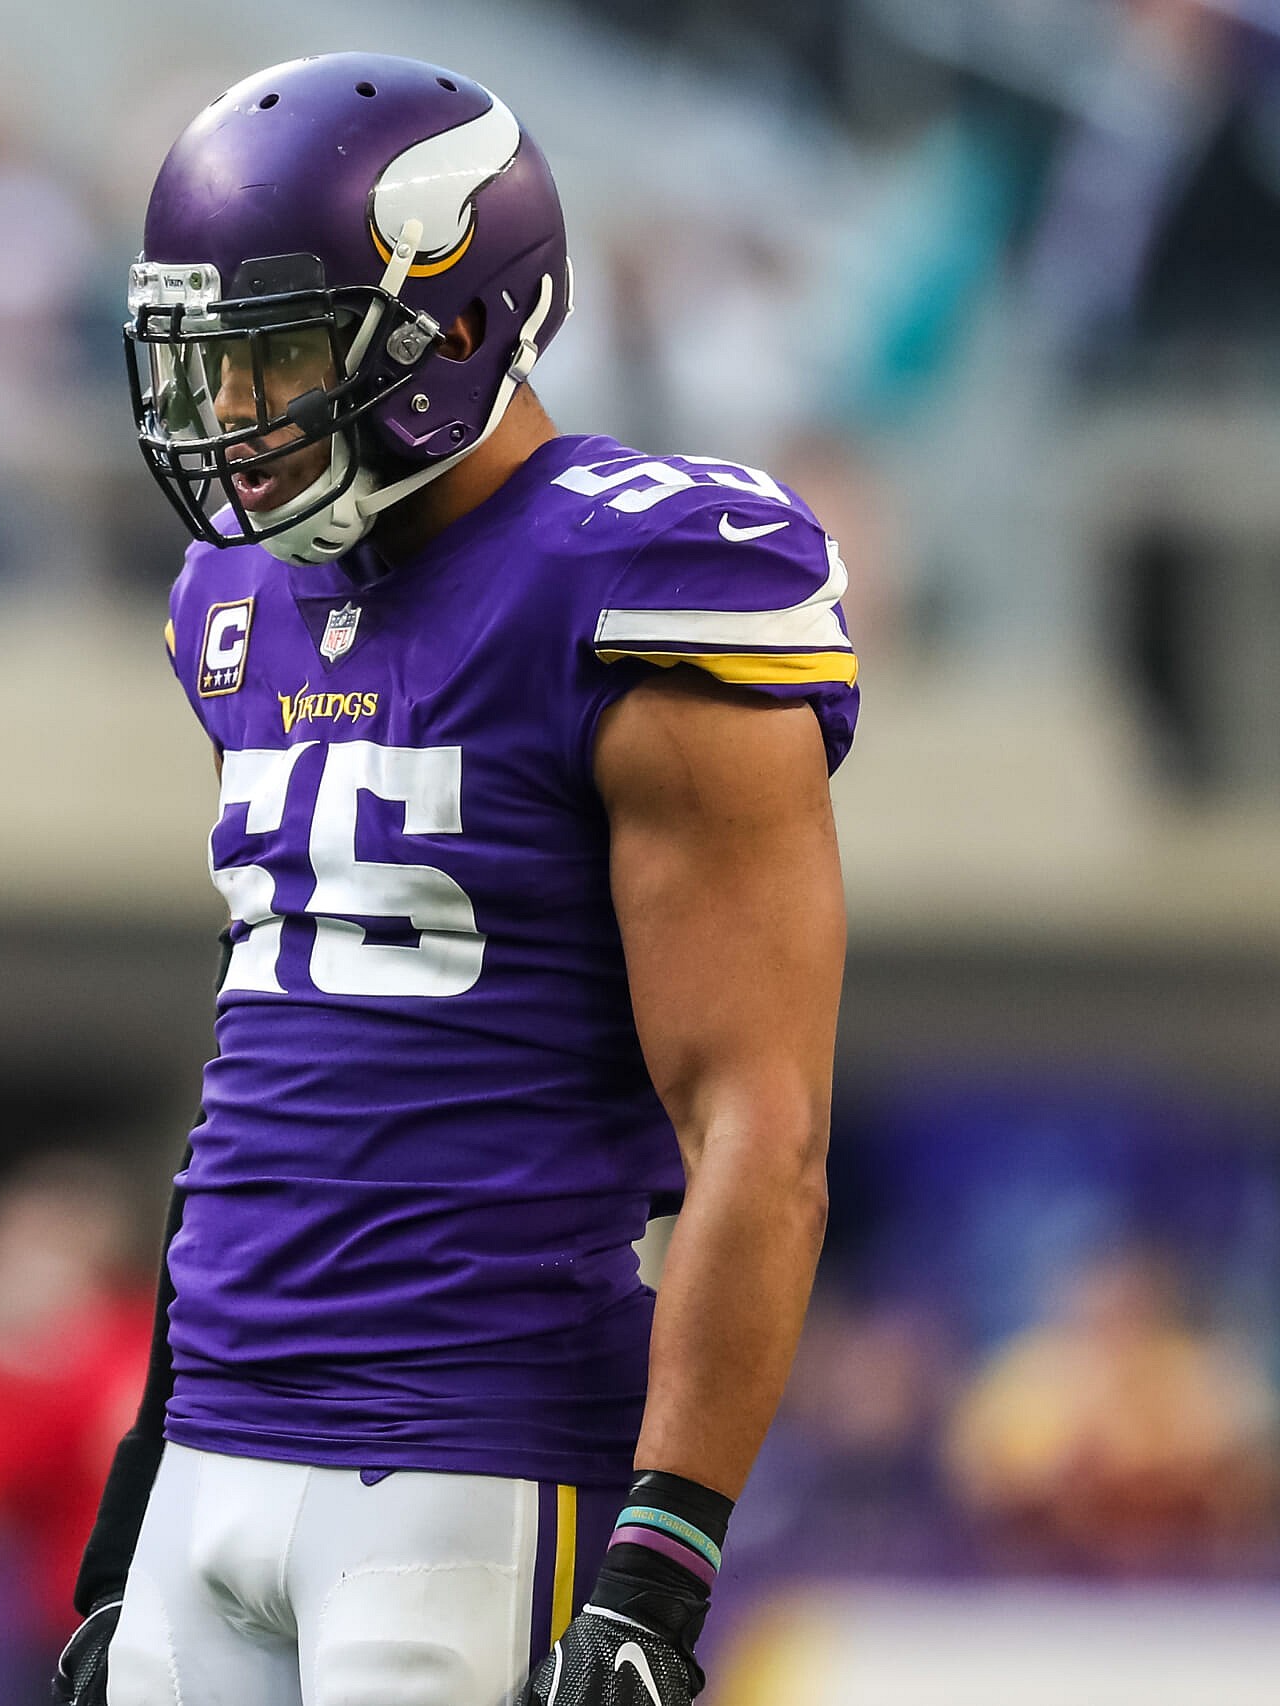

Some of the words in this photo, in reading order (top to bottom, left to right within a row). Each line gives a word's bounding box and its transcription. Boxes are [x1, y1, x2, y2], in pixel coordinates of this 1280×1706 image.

[205, 605, 248, 670] C
[327, 628, 349, 651] NFL
[208, 740, 488, 997] 55
